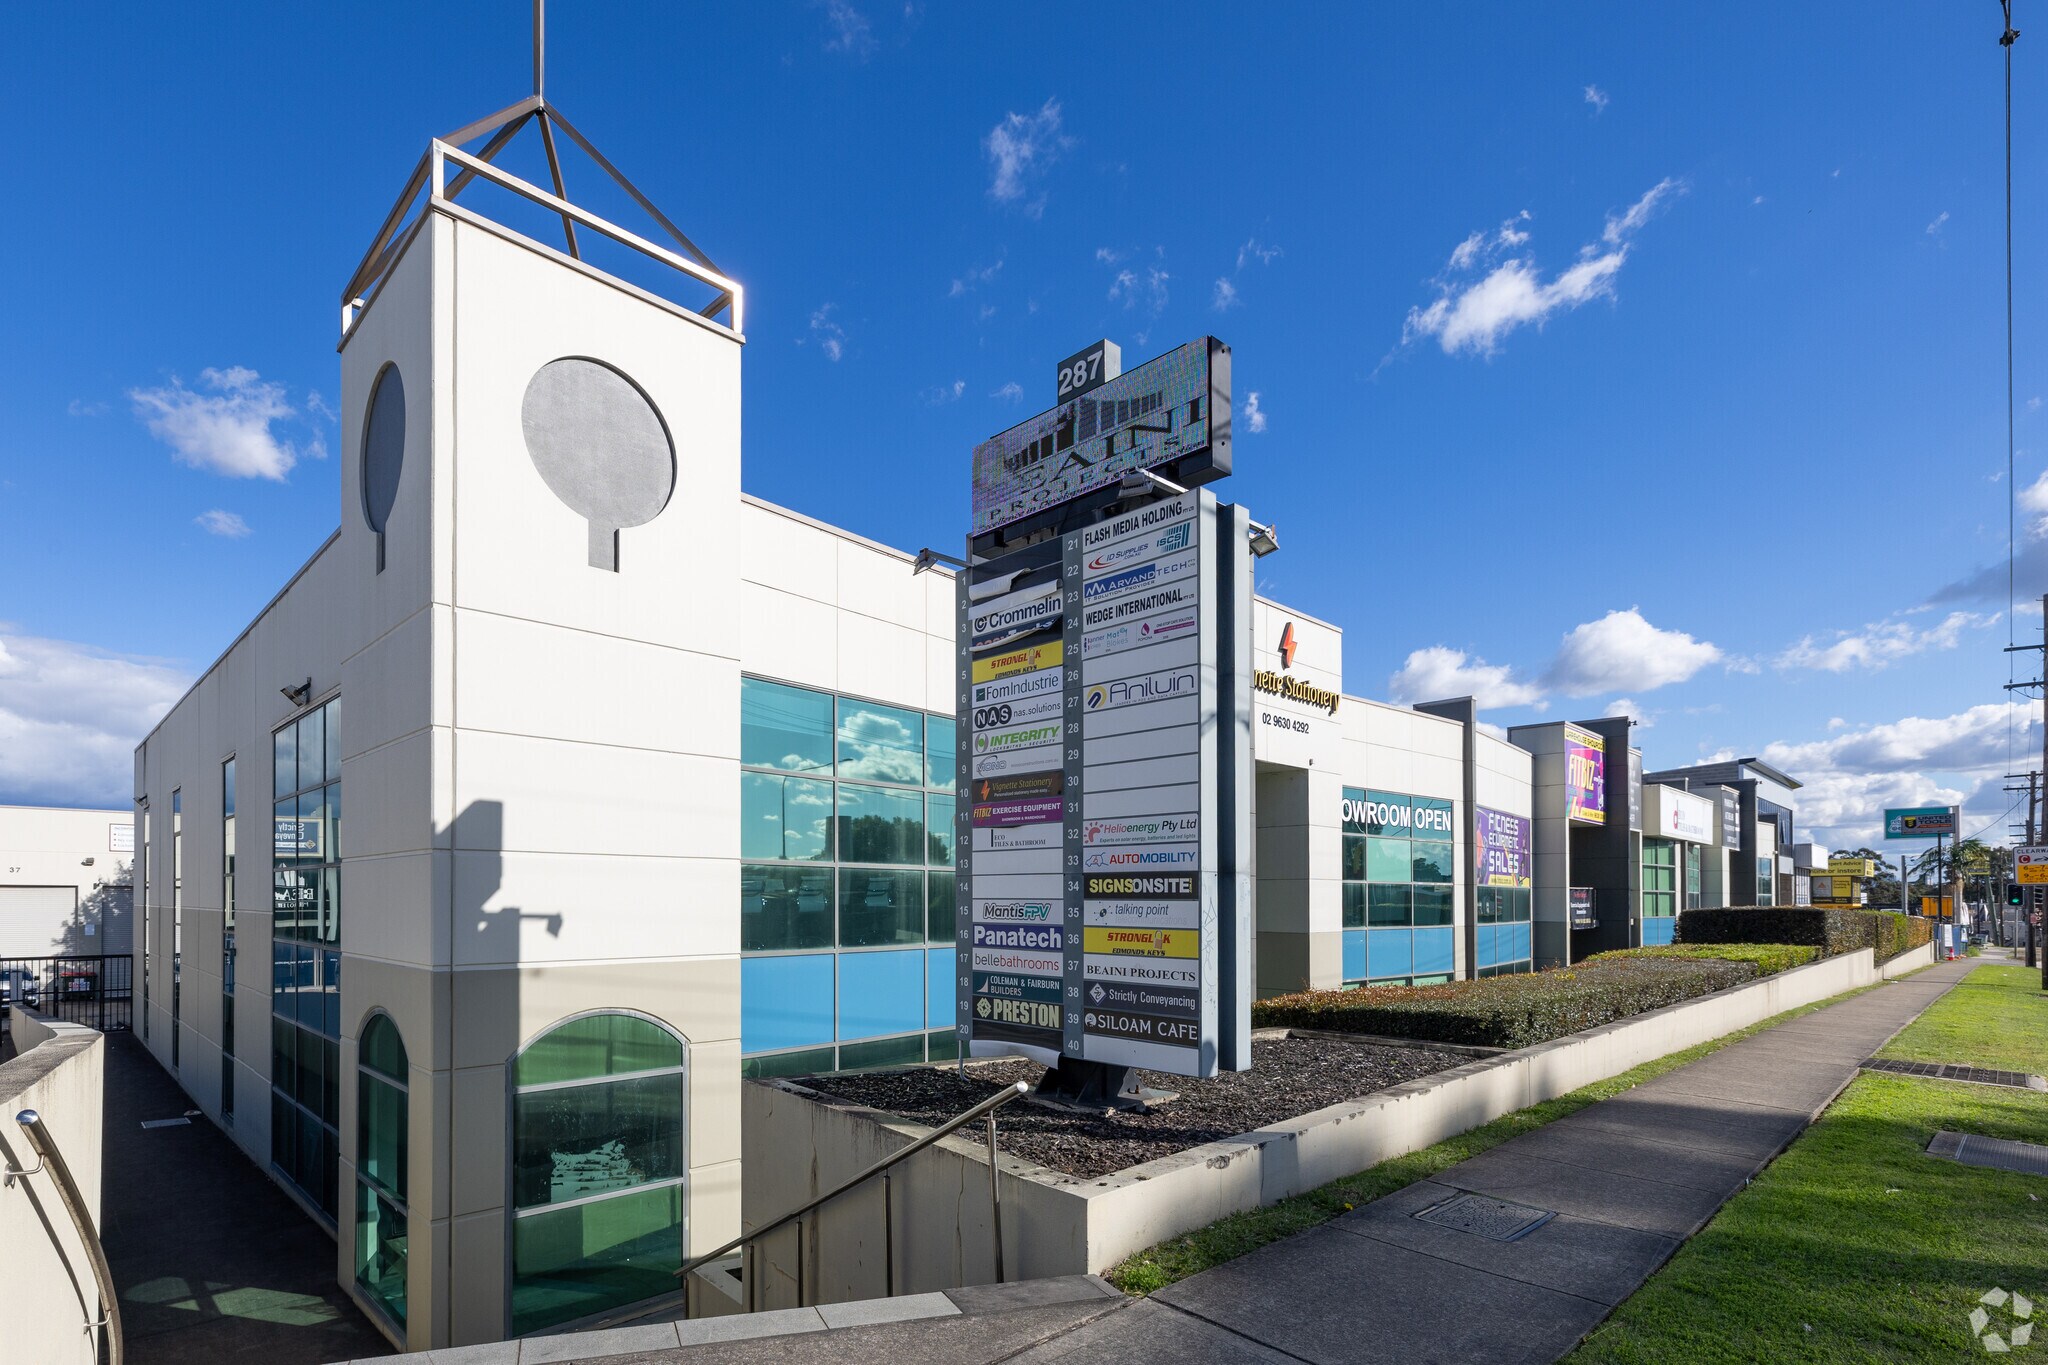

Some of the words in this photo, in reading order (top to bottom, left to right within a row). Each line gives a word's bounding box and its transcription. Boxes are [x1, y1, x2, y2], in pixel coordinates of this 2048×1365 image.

[1059, 350, 1103, 397] 287
[987, 393, 1206, 508] EAINI
[989, 433, 1181, 520] PROJECTS
[1085, 525, 1111, 547] FLASH
[1112, 516, 1140, 531] MEDIA
[1141, 501, 1182, 525] HOLDING
[1067, 538, 1079, 551] 21
[1106, 553, 1115, 562] ID
[1115, 543, 1149, 559] SUPPLIES
[1156, 533, 1182, 547] ISCS
[1067, 565, 1079, 577] 22
[962, 576, 966, 586] 1
[1093, 589, 1123, 600] SOLUTION
[1125, 580, 1155, 592] PROVIDER
[1067, 591, 1079, 603] 23
[961, 600, 967, 609] 2
[1085, 606, 1114, 626] WEDGE
[1115, 588, 1183, 618] INTERNATIONAL
[989, 597, 1061, 628] Crommelin
[961, 624, 967, 633] 3
[1067, 617, 1079, 629] 24
[961, 647, 967, 657] 4
[1067, 643, 1079, 655] 25
[1022, 664, 1038, 674] KEYS
[961, 670, 967, 680] 5
[1067, 670, 1079, 681] 26
[986, 674, 1059, 700] FomIndustrie
[961, 694, 967, 703] 6
[1285, 675, 1340, 714] Stationery
[1067, 696, 1079, 708] 27
[977, 707, 1010, 726] NAS
[1013, 702, 1061, 718] nas.solutions
[961, 718, 967, 727] 7
[1262, 713, 1271, 726] 02
[1273, 714, 1291, 730] 9630
[1292, 721, 1310, 734] 4292
[1067, 723, 1079, 734] 28
[990, 726, 1061, 747] INTEGRITY
[961, 741, 967, 750] 8
[990, 743, 1022, 752] LOCKSMITHS
[1029, 739, 1056, 747] SECURITY
[1067, 749, 1079, 760] 29
[961, 764, 967, 774] 9
[976, 760, 1007, 773] MONO
[1568, 754, 1595, 791] FITBIZ
[993, 781, 1018, 792] Vignette
[1019, 778, 1053, 788] Stationery
[1067, 776, 1079, 787] 30
[960, 788, 969, 797] 10
[993, 806, 1022, 815] EXERCISE
[1023, 803, 1061, 812] EQUIPMENT
[1068, 802, 1079, 813] 31
[960, 812, 969, 821] 11
[1415, 808, 1451, 831] OPEN
[1103, 823, 1161, 835] Helioenergy
[1161, 821, 1178, 833] Pty
[1180, 819, 1197, 830] Ltd
[1067, 829, 1079, 839] 32
[960, 836, 969, 845] 12
[1015, 839, 1046, 847] BATHROOM
[1067, 855, 1079, 866] 33
[1109, 852, 1196, 865] AUTOMOBILITY
[1488, 850, 1519, 874] SALES
[1843, 859, 1863, 867] Advice
[960, 860, 969, 869] 13
[960, 883, 969, 892] 14
[1067, 881, 1080, 891] 34
[1089, 878, 1190, 893] SIGNSONSITE
[960, 906, 969, 915] 15
[1067, 907, 1080, 918] 35
[1115, 904, 1144, 916] talking
[1146, 904, 1168, 917] point
[960, 930, 969, 939] 16
[974, 925, 1062, 948] Panatech
[1067, 934, 1079, 944] 36
[1112, 947, 1145, 956] EDMONDS
[1147, 948, 1166, 957] KEYS
[960, 954, 969, 962] 17
[975, 953, 1060, 971] bellebathrooms
[1067, 960, 1079, 971] 37
[1086, 965, 1127, 977] BEAINI
[1130, 969, 1196, 982] PROJECTS
[960, 977, 969, 986] 18
[990, 976, 1019, 986] COLEMAN
[1021, 979, 1026, 987] &
[1028, 979, 1060, 990] FAIRBURN
[990, 987, 1022, 996] BUILDERS
[1067, 987, 1079, 997] 38
[1109, 989, 1137, 1004] Strictly
[1140, 992, 1196, 1010] Conveyancing
[960, 1001, 969, 1010] 19
[993, 999, 1060, 1028] PRESTON
[1067, 1013, 1079, 1024] 39
[960, 1025, 969, 1034] 20
[1098, 1014, 1151, 1034] SILOAM
[1157, 1022, 1198, 1040] CAFE
[1067, 1040, 1079, 1051] 40
